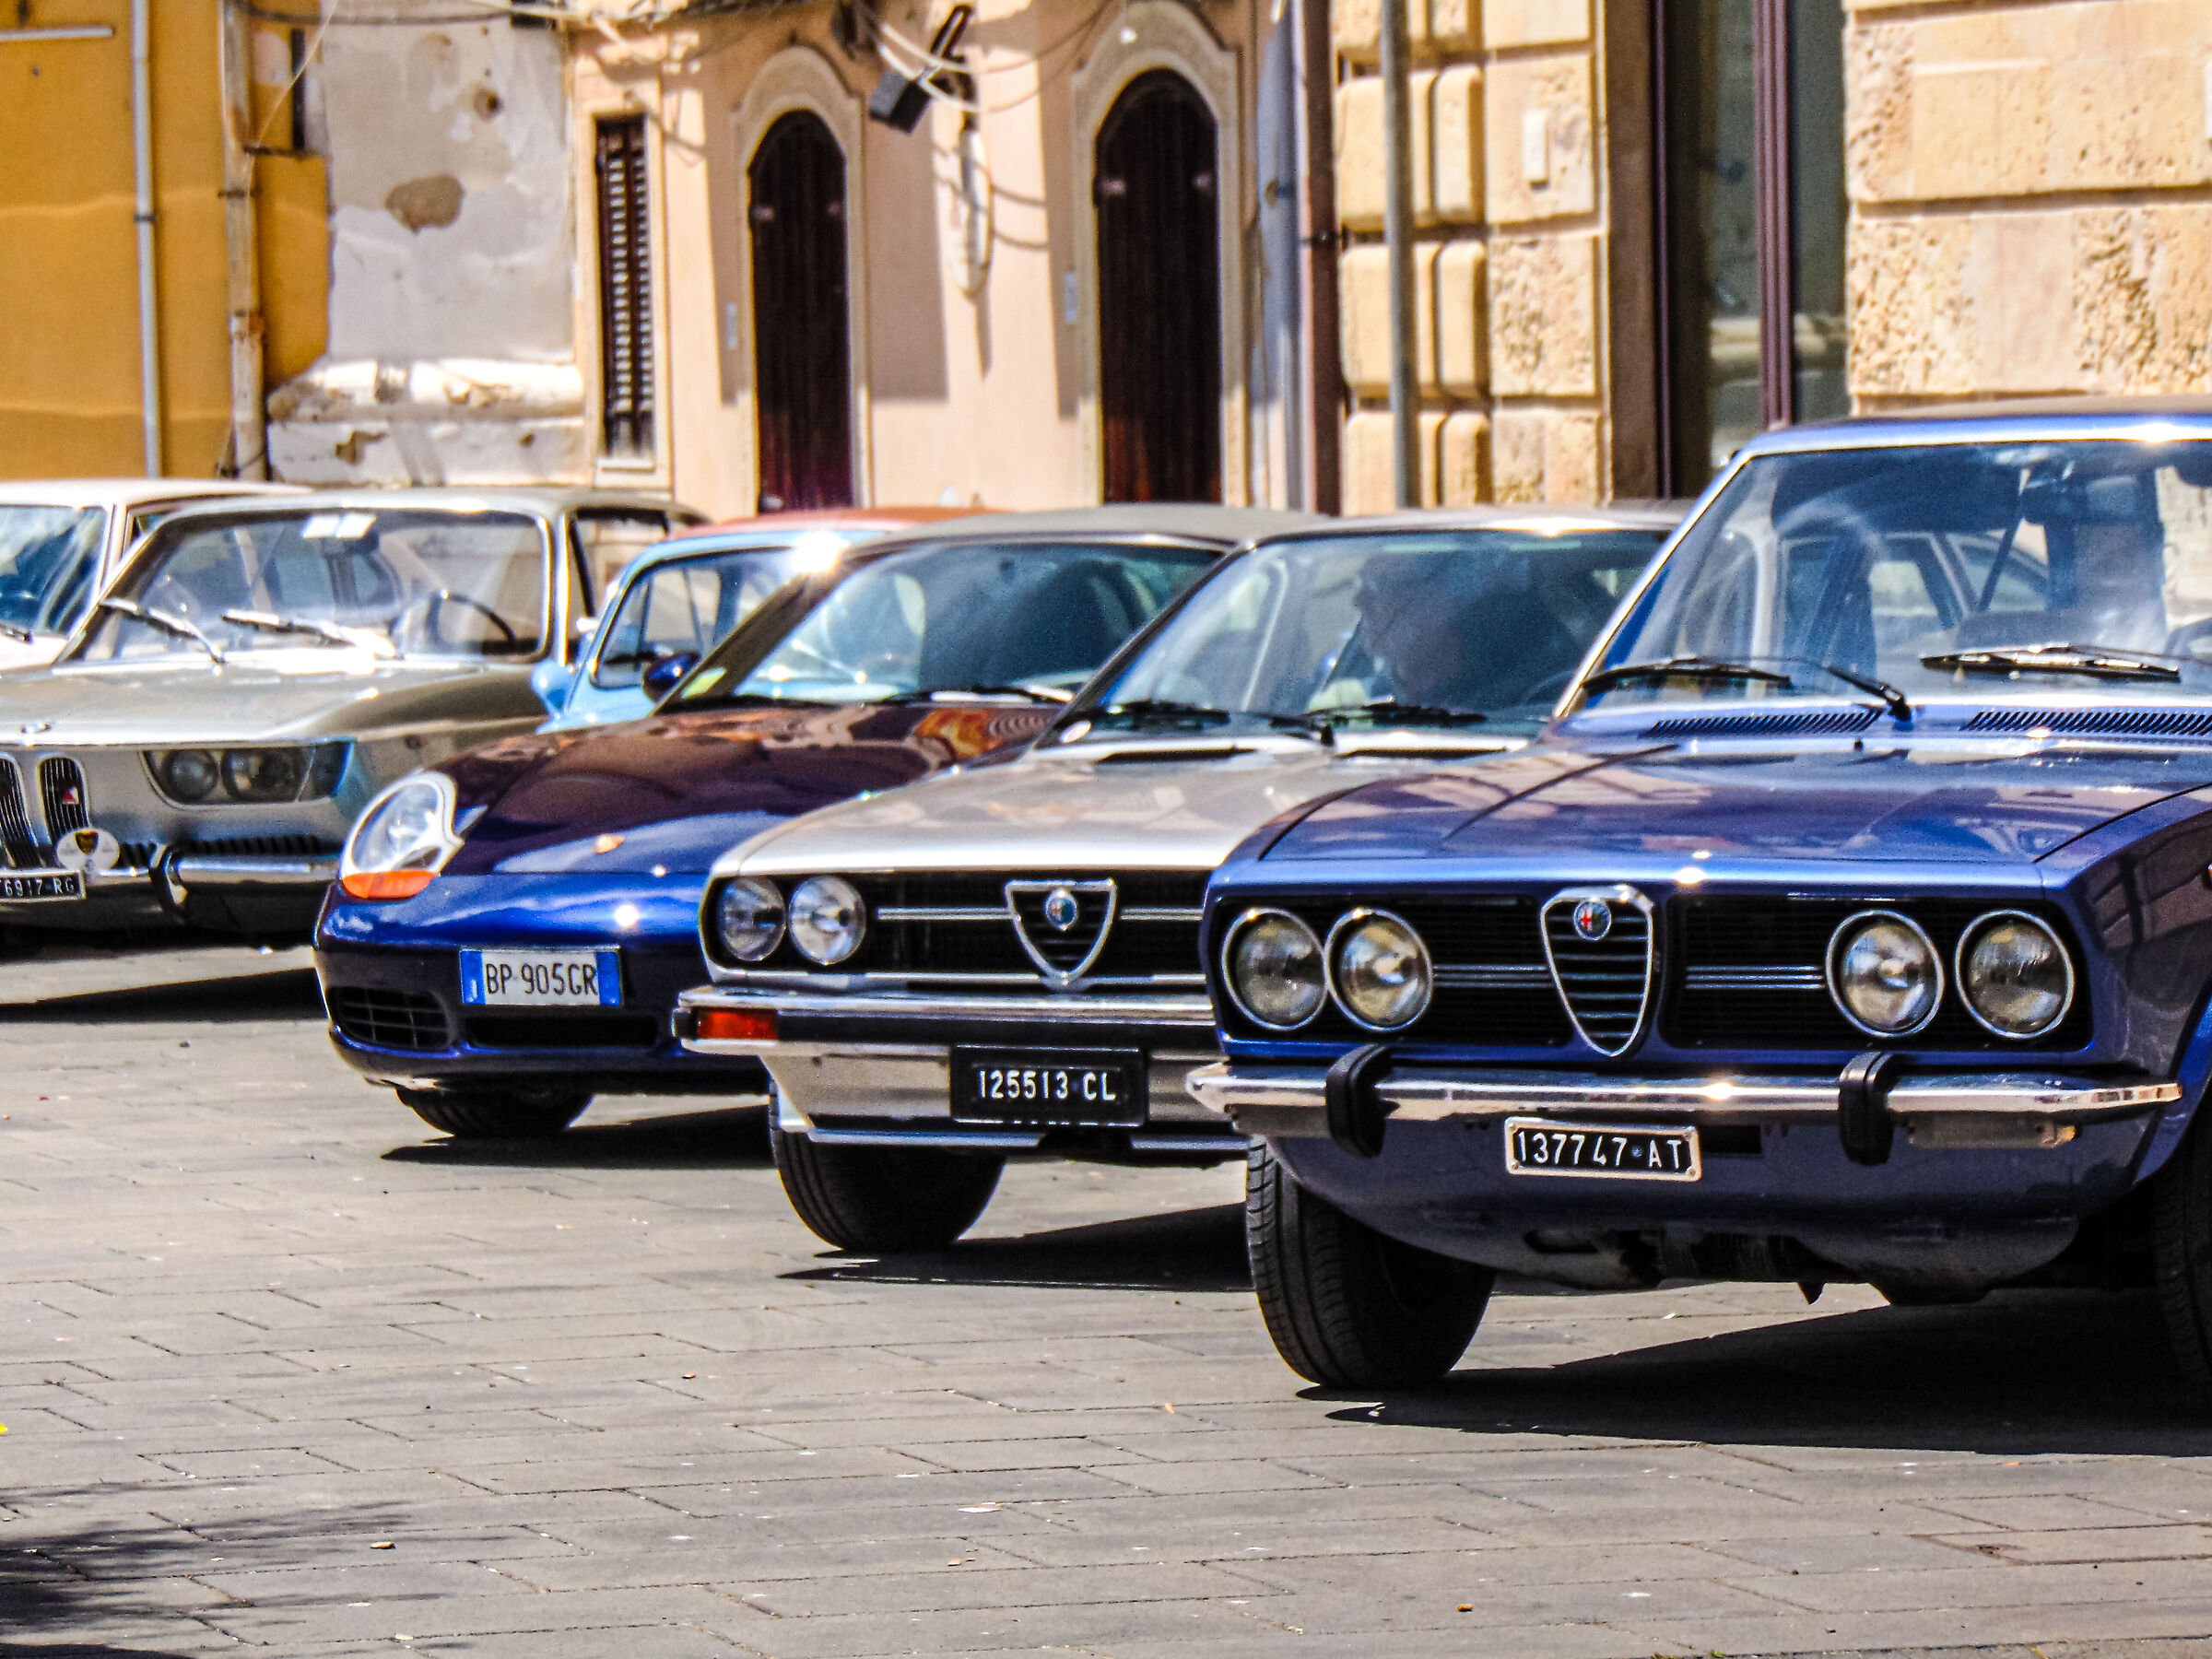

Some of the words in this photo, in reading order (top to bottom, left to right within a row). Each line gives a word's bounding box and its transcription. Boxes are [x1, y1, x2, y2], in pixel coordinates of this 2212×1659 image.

[0, 878, 42, 897] 6917
[485, 963, 512, 994] BP
[978, 1069, 1068, 1099] 125513
[1082, 1071, 1116, 1100] CL
[1518, 1130, 1628, 1167] 137747
[1648, 1139, 1683, 1170] AT
